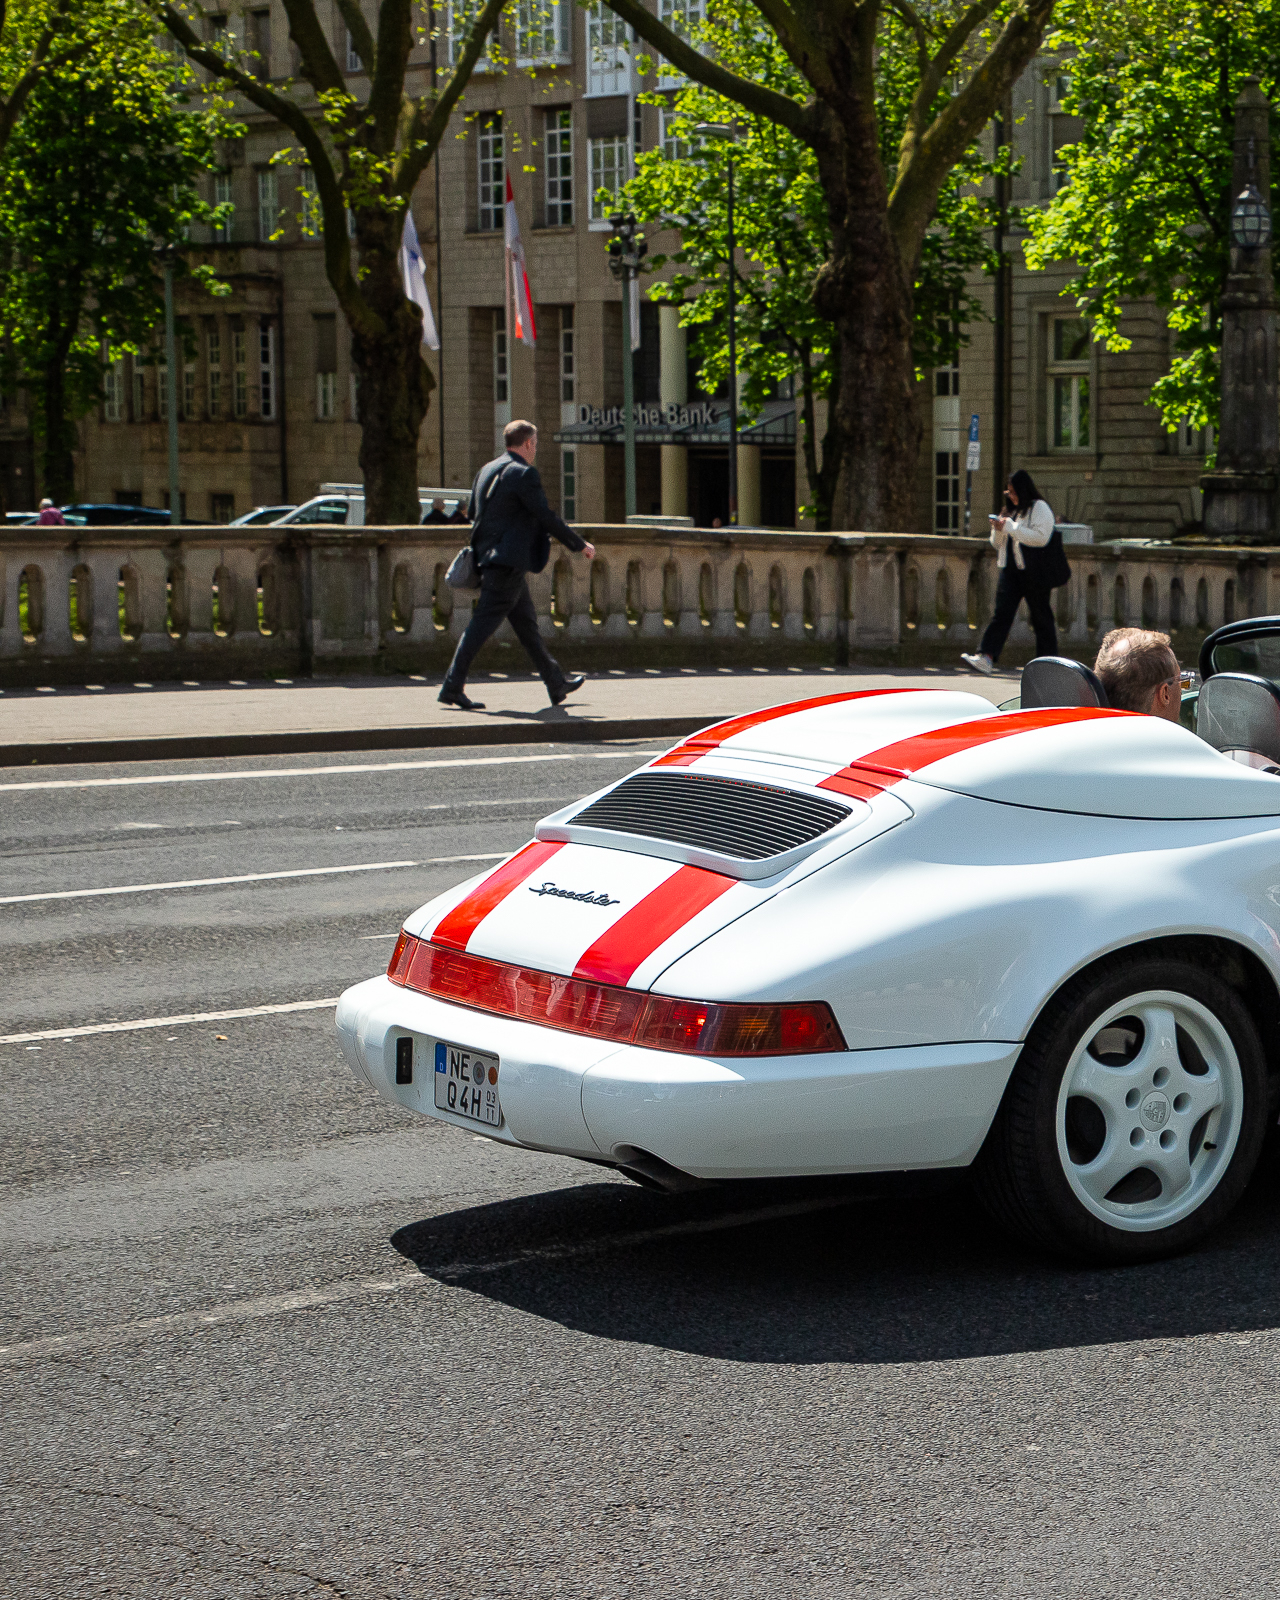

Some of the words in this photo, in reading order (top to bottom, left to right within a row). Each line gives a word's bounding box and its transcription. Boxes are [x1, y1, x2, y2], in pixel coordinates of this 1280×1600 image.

[667, 402, 713, 425] Bank
[528, 882, 621, 907] Speedster
[439, 1062, 444, 1072] D
[450, 1050, 470, 1082] NE
[447, 1080, 482, 1117] Q4H
[486, 1090, 496, 1103] 03
[486, 1107, 494, 1121] 11
